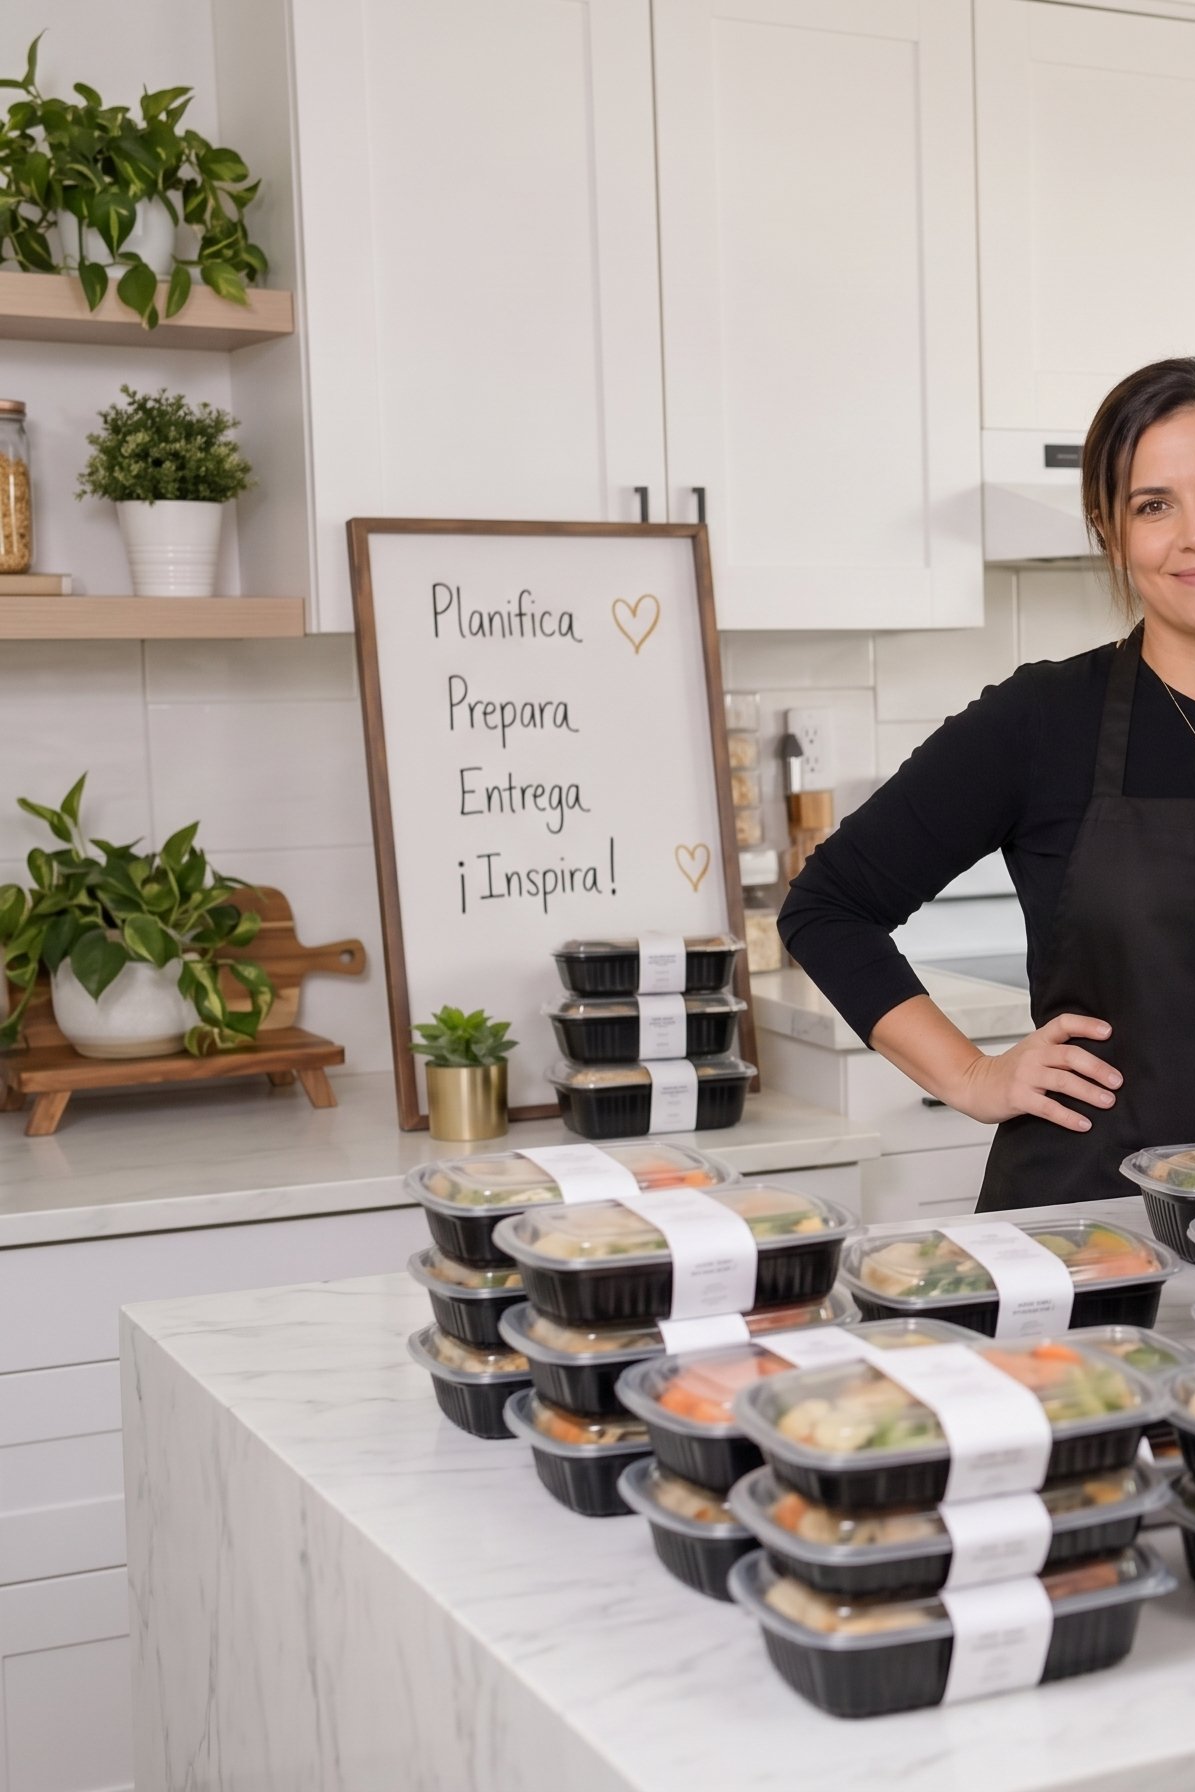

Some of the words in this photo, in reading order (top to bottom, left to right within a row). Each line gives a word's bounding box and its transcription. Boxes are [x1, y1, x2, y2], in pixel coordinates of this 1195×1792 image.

[431, 582, 583, 643] Planifica
[448, 674, 580, 750] Prepara
[459, 766, 591, 835] Entrega
[457, 836, 617, 915] ¡Inspira!
